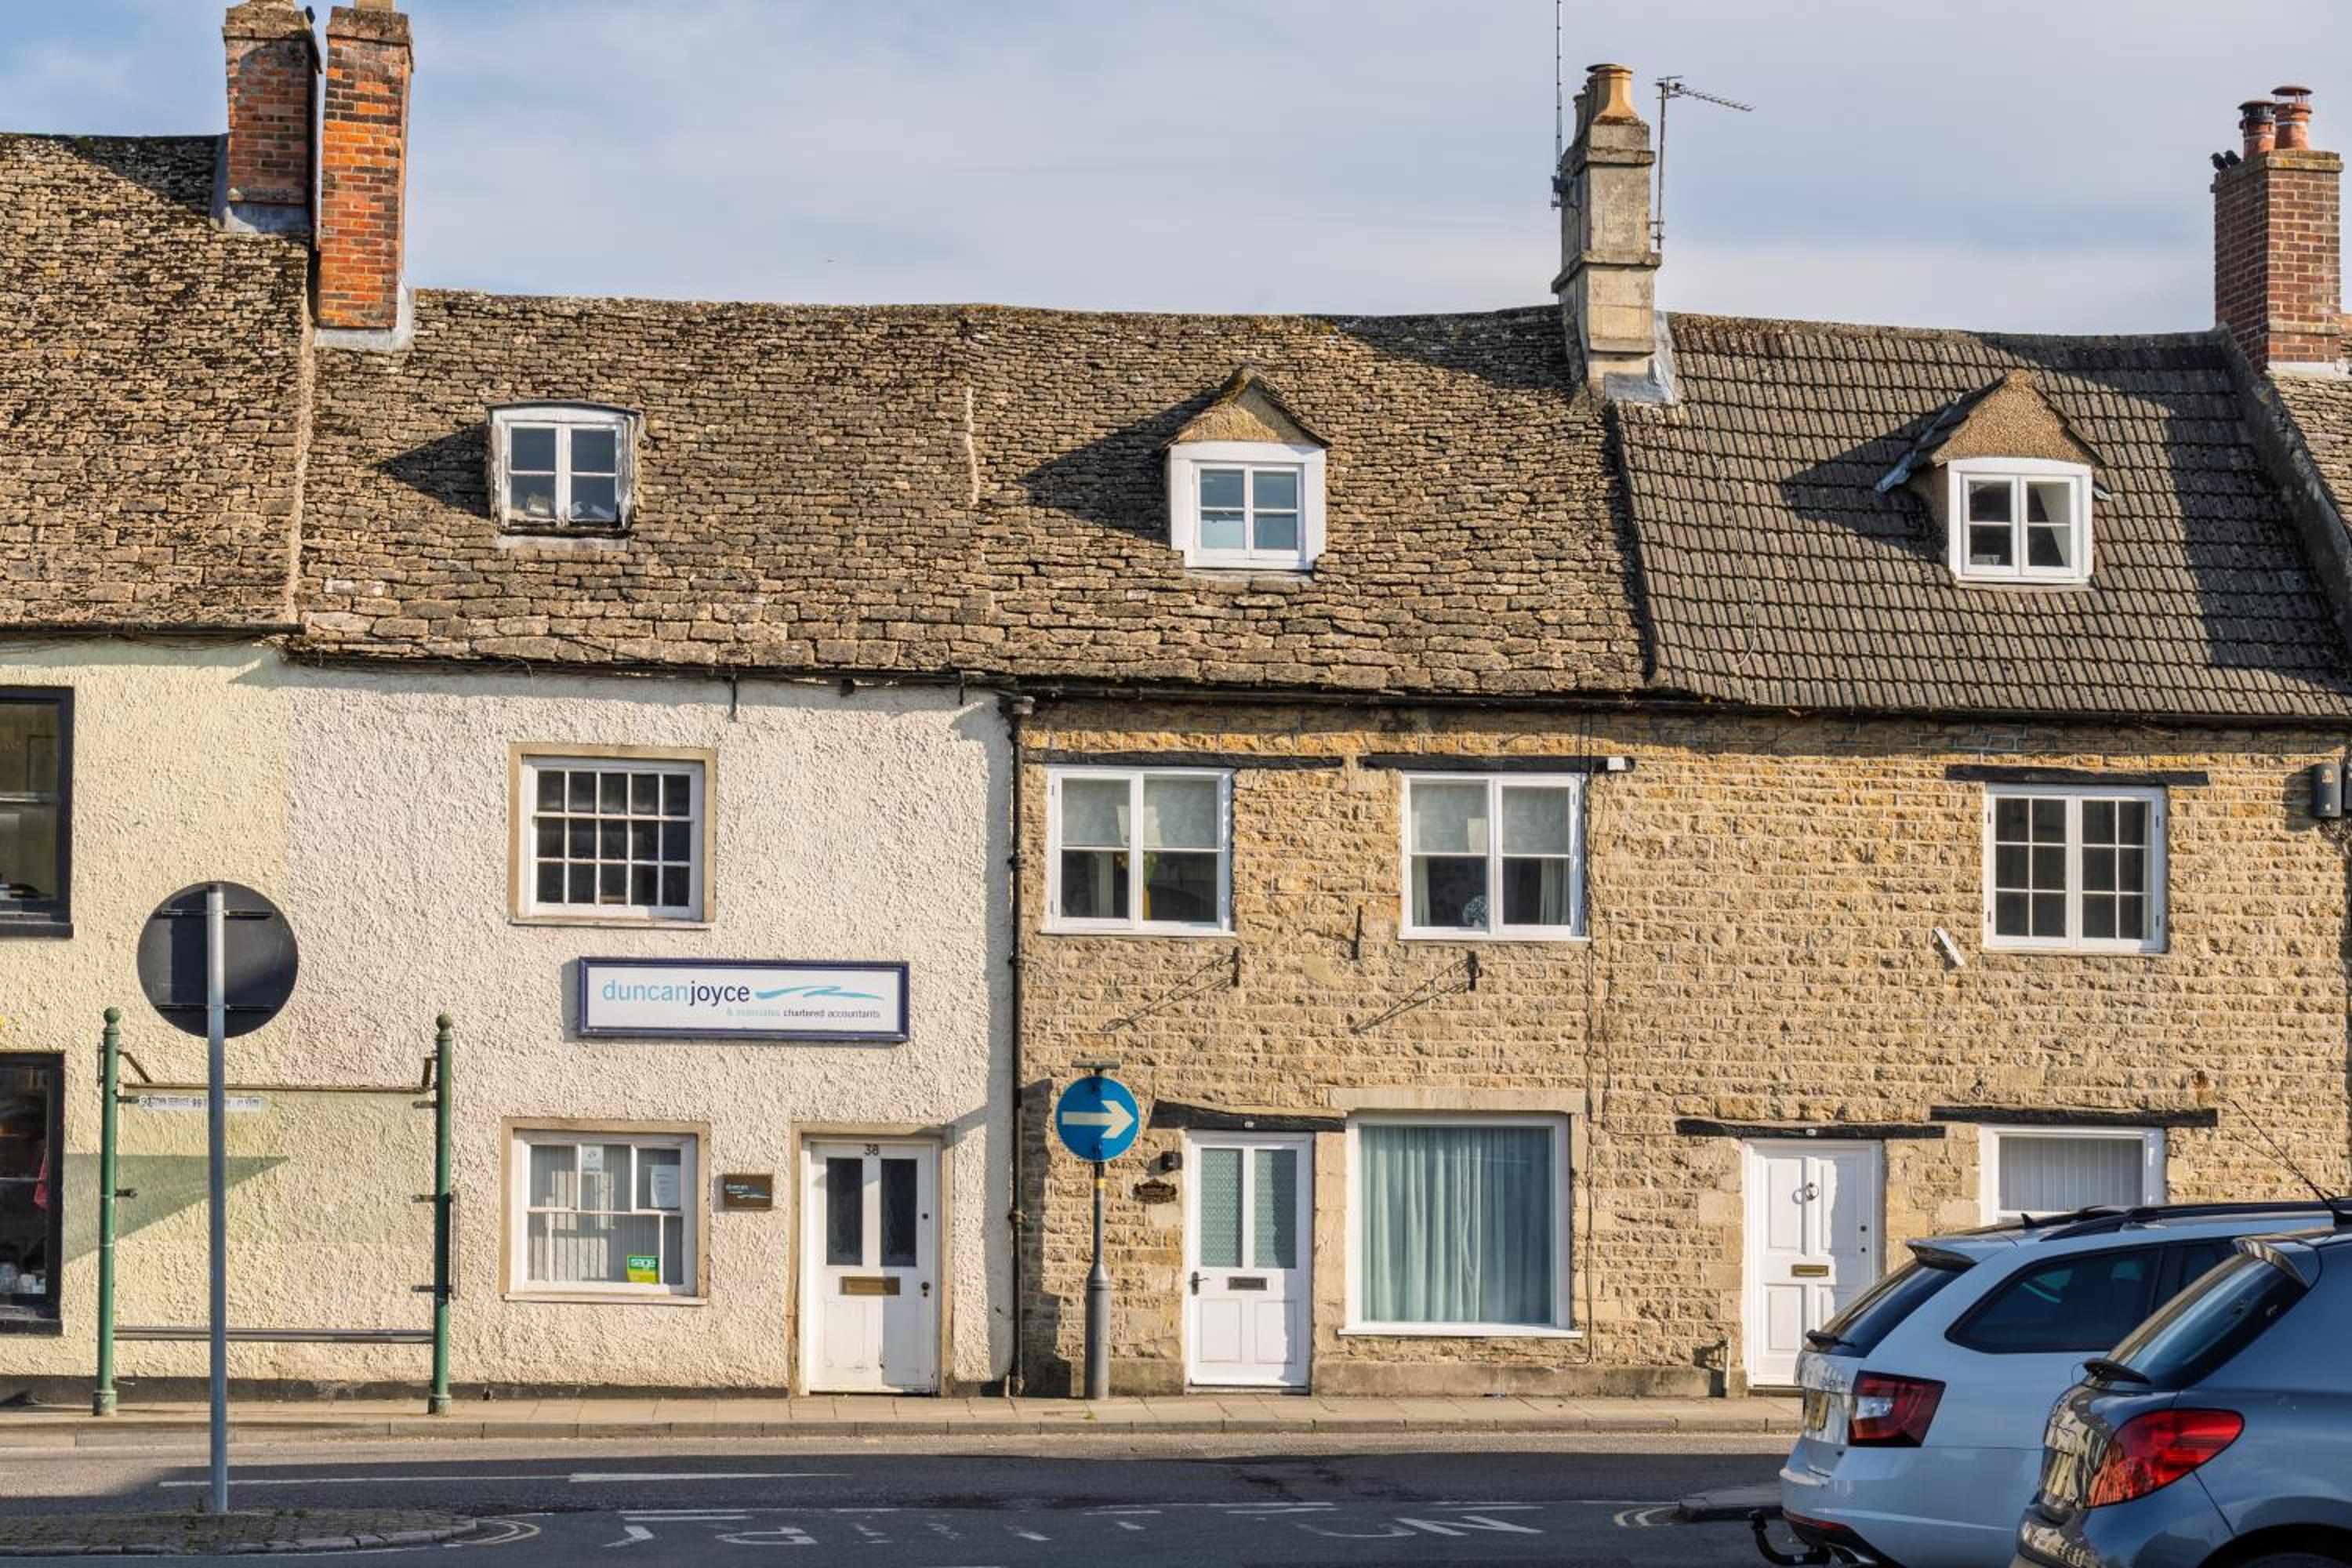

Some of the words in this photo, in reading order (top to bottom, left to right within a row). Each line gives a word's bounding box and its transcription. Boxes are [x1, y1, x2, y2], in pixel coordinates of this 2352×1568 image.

[602, 979, 750, 1007] duncanjoyce
[783, 1008, 825, 1018] chartered
[827, 1009, 881, 1019] accountants
[864, 1144, 879, 1156] 38
